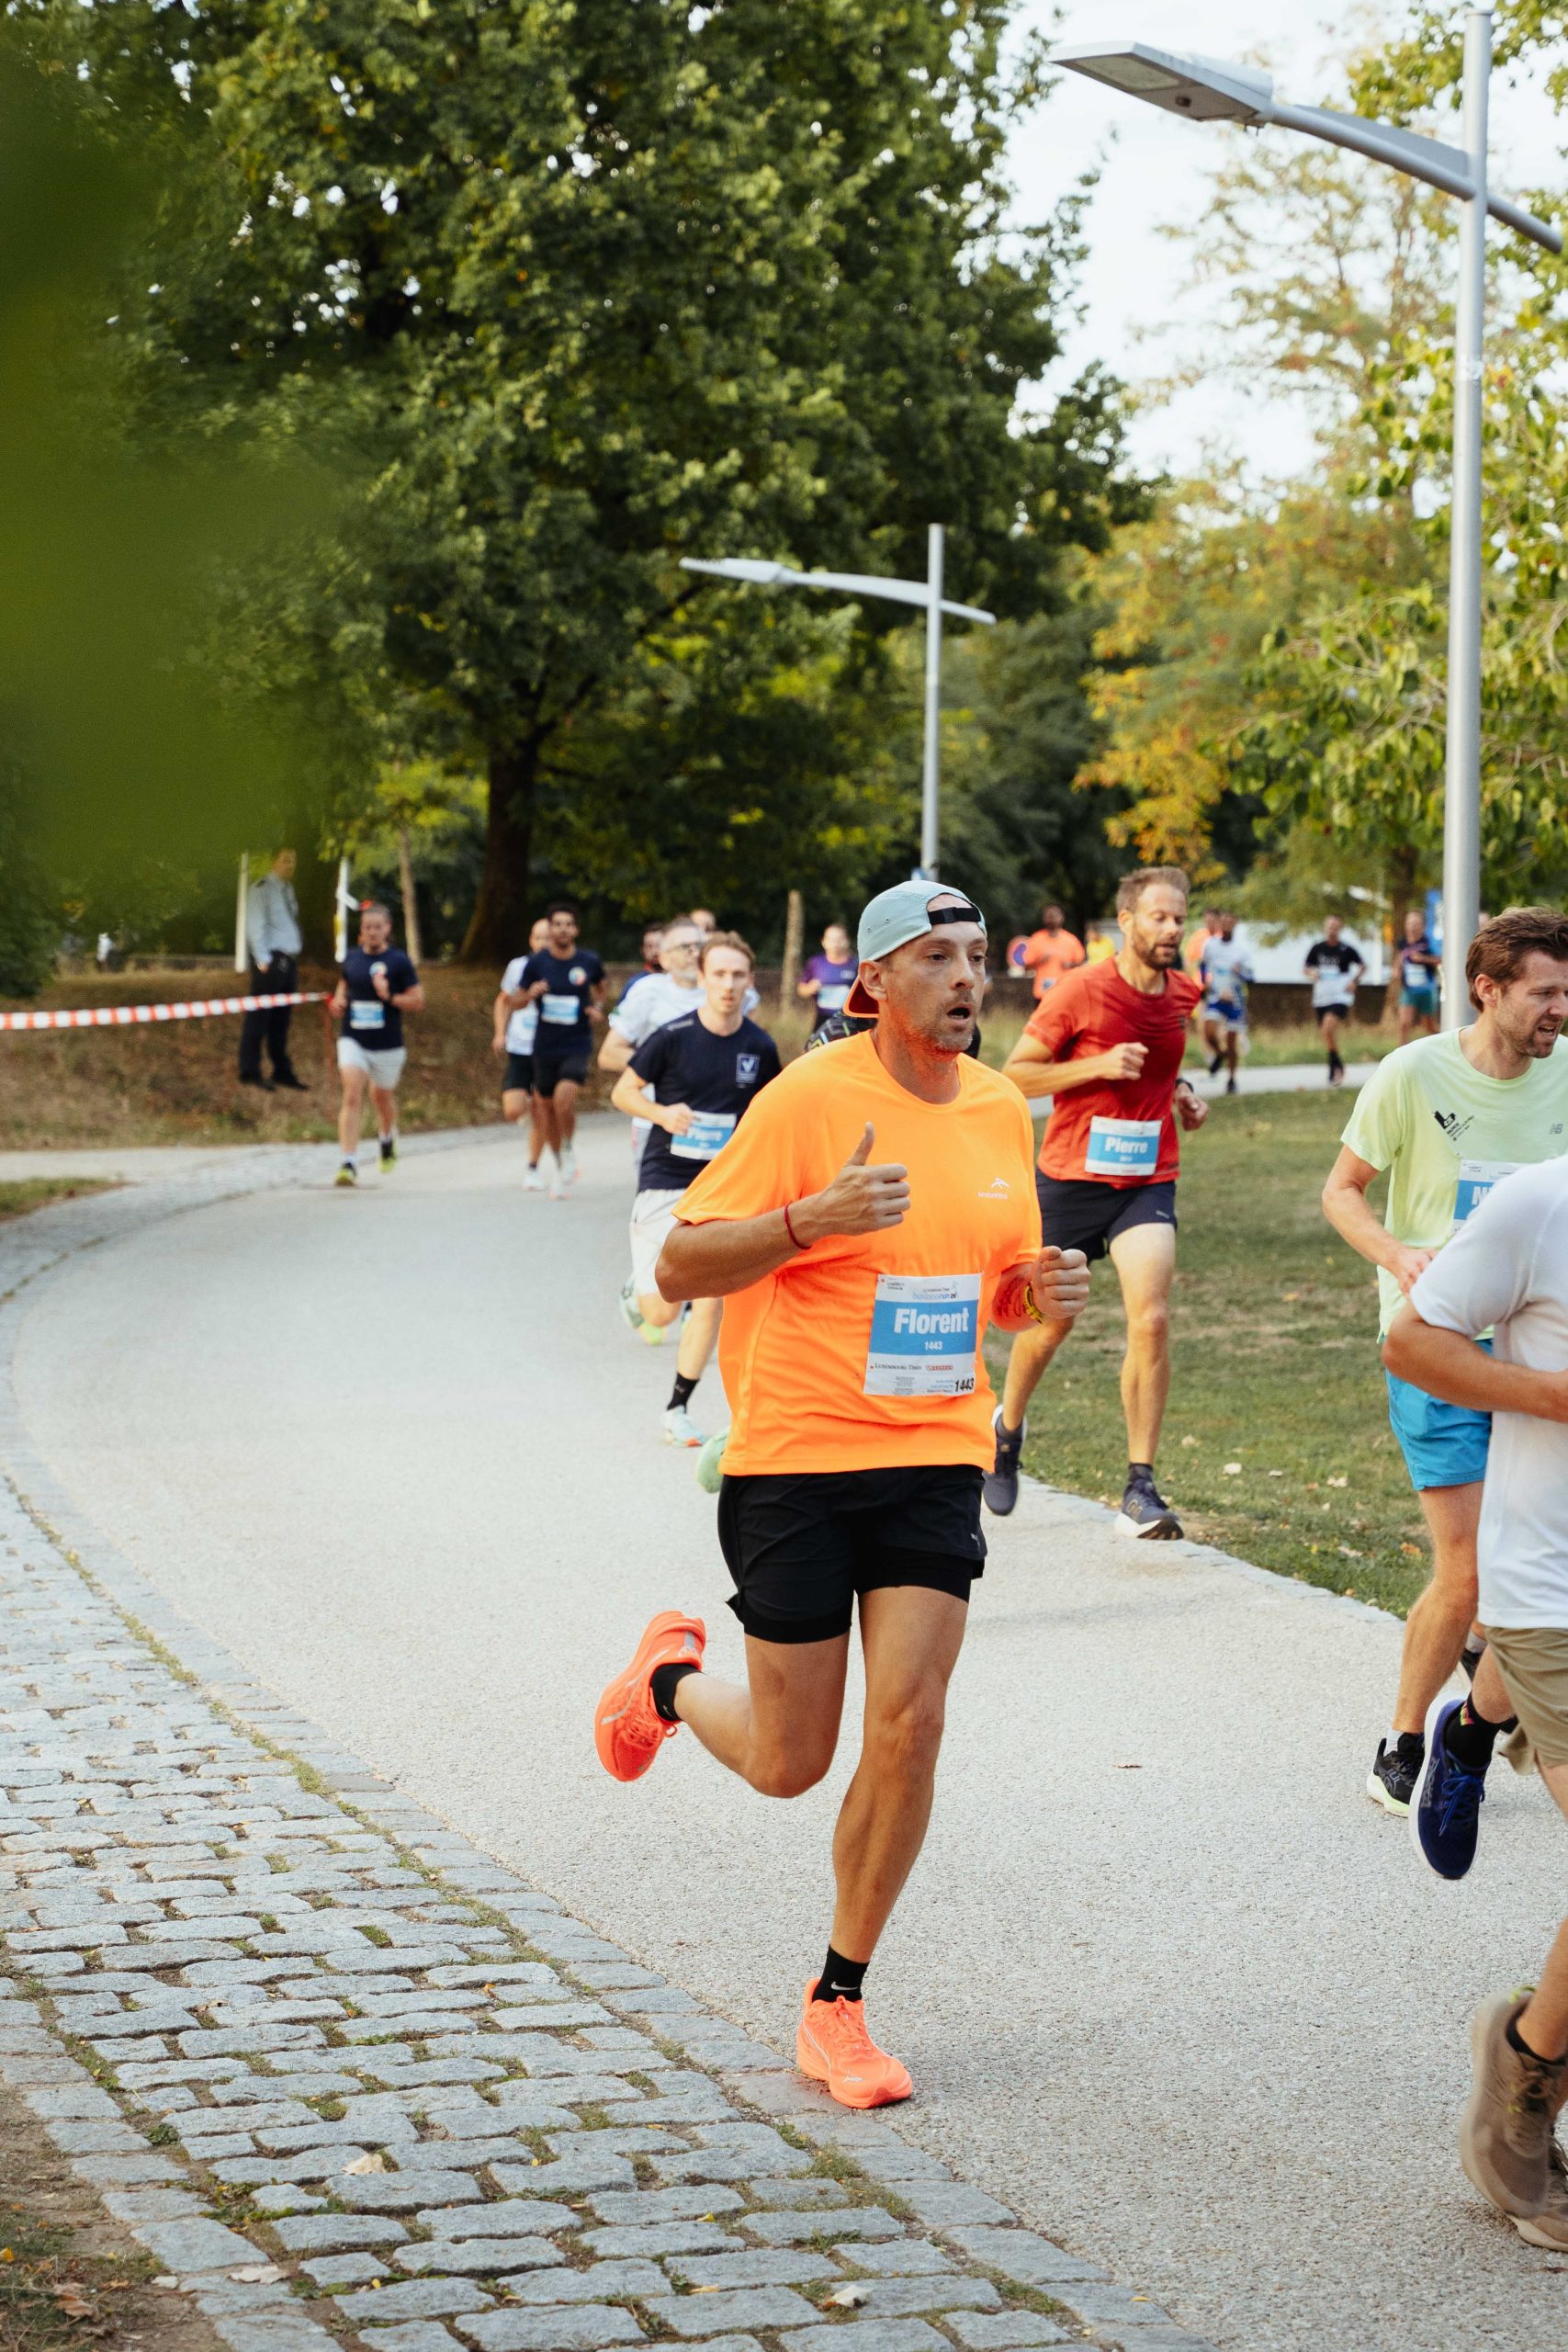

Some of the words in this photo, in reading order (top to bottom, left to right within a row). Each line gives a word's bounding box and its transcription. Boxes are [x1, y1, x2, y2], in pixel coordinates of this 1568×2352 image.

[1104, 1136, 1148, 1154] Pierre
[894, 1307, 970, 1334] Florent
[924, 1340, 942, 1351] 1443
[954, 1377, 975, 1393] 1443
